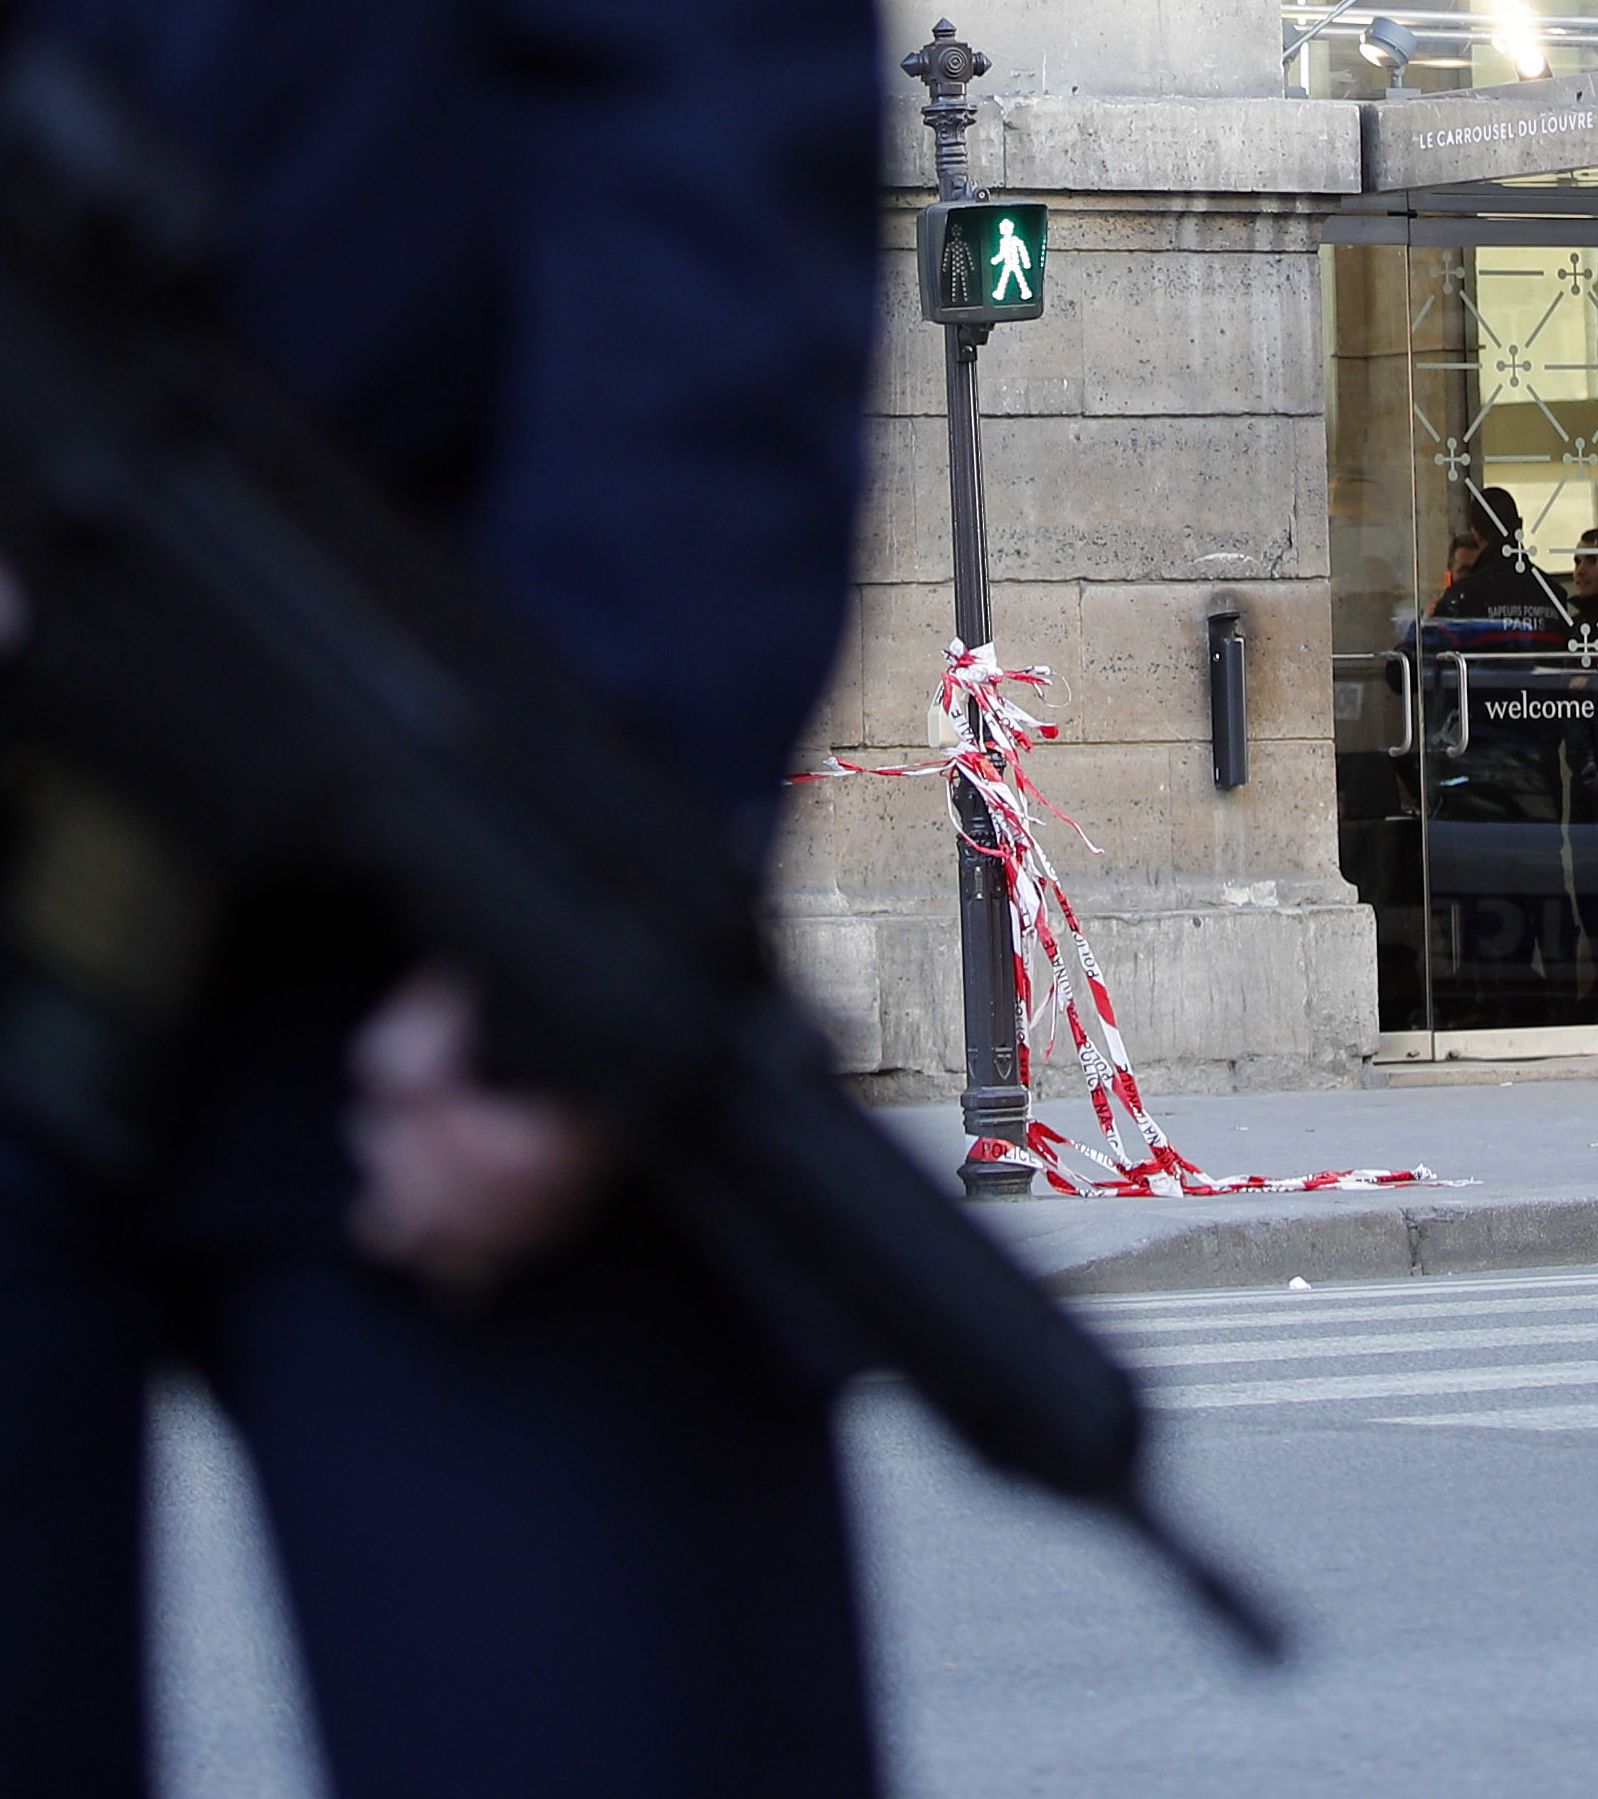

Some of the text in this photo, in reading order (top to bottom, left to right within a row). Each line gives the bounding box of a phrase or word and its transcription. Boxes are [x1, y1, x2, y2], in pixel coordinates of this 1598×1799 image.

[1419, 111, 1594, 150] LE CARROUSEL DU LOUVRE
[1487, 605, 1522, 618] SAPEURS
[1502, 617, 1545, 631] PARIS
[1484, 690, 1596, 720] welcome
